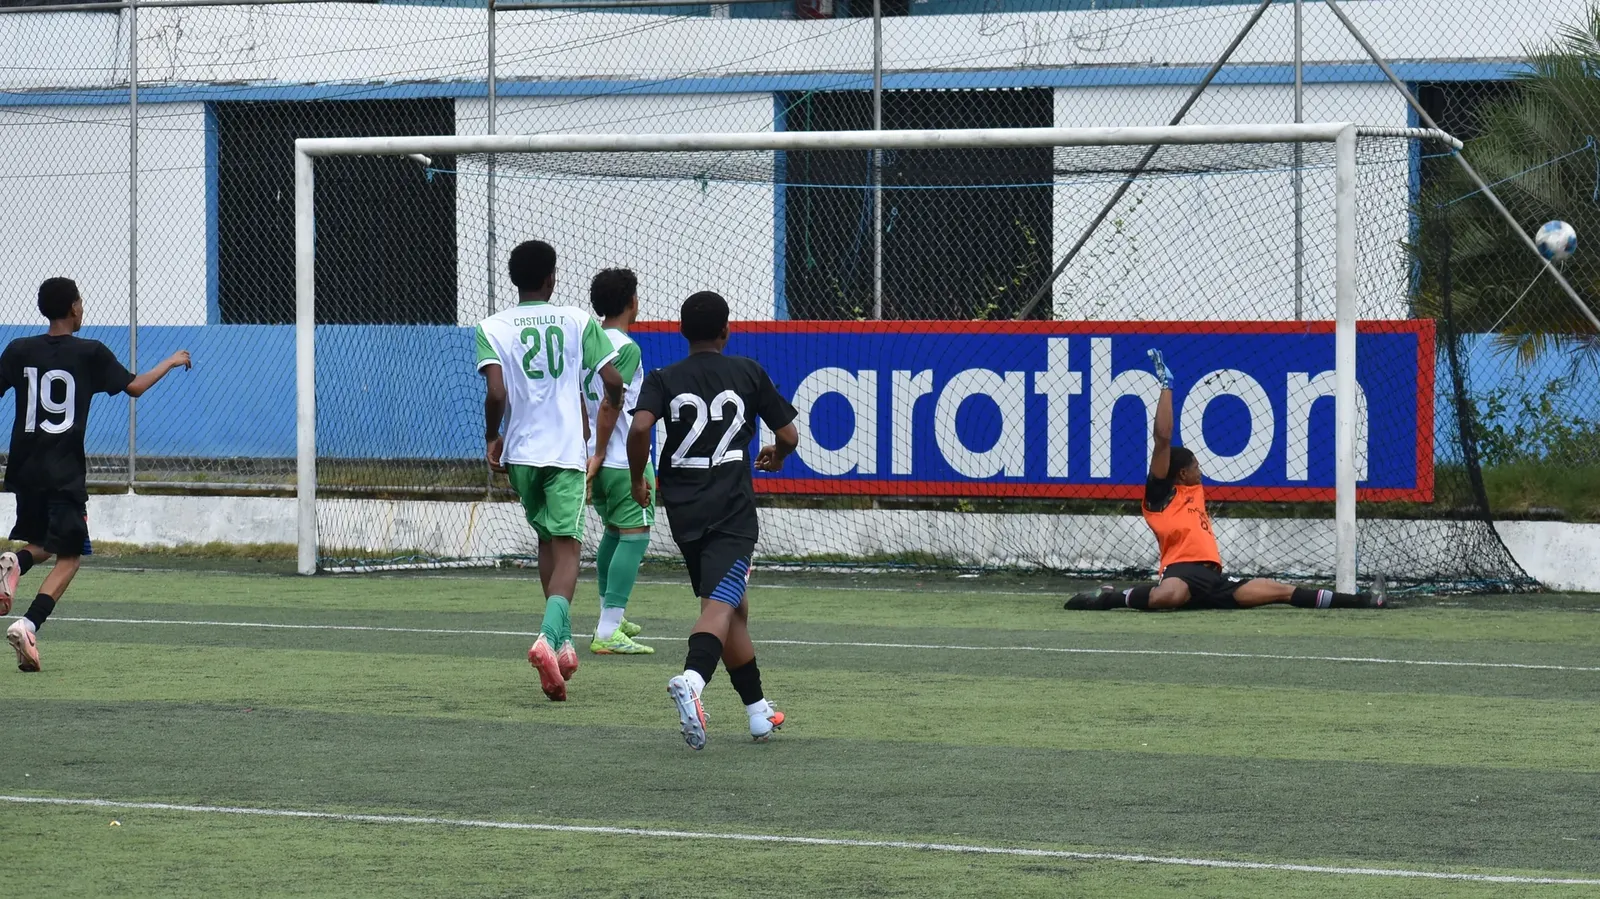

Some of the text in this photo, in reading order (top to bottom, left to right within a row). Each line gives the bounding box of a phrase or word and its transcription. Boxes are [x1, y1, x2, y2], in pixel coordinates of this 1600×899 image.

[513, 314, 567, 327] CASTILLO T.
[520, 325, 564, 379] 20
[23, 366, 76, 434] 19
[656, 336, 1368, 482] arathon
[669, 389, 747, 469] 22
